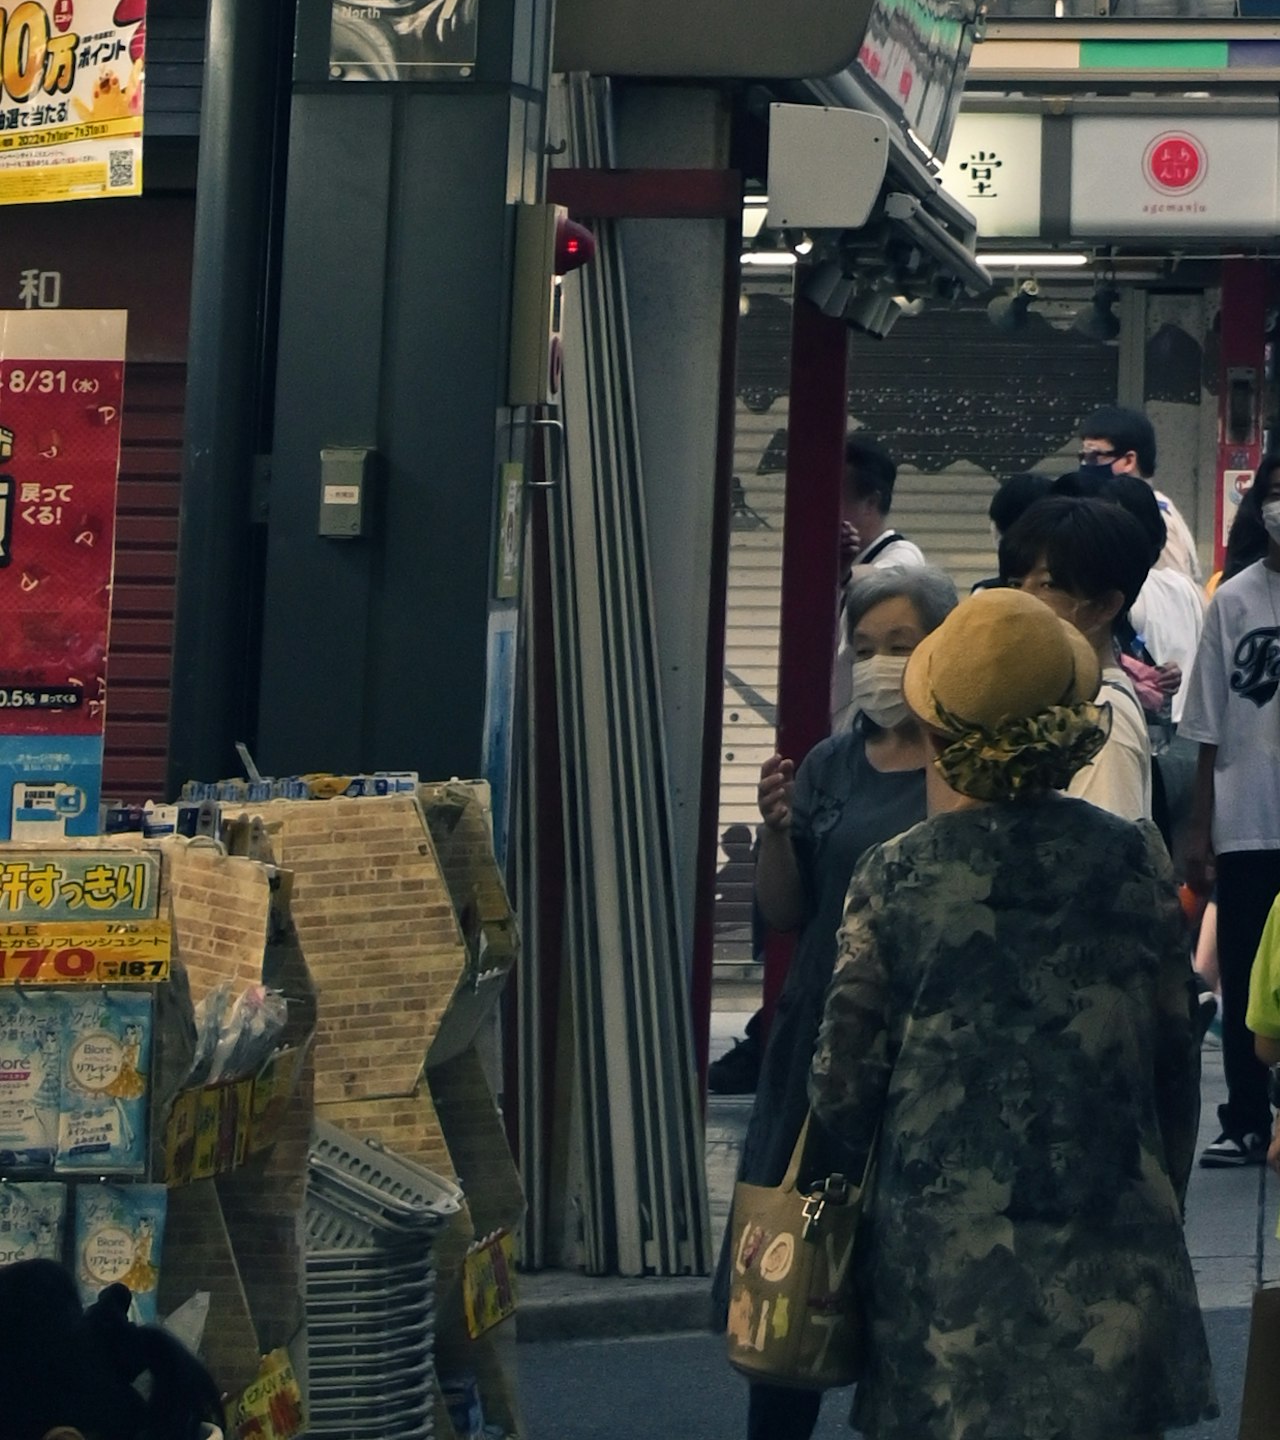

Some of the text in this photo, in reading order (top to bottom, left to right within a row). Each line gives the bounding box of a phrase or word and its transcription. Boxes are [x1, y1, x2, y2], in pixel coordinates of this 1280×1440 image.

[0, 0, 79, 102] 0万
[78, 39, 126, 70] ポイント
[960, 151, 1002, 198] 堂
[19, 269, 61, 308] 和
[20, 482, 73, 503] 戻って
[21, 505, 63, 525] くる!
